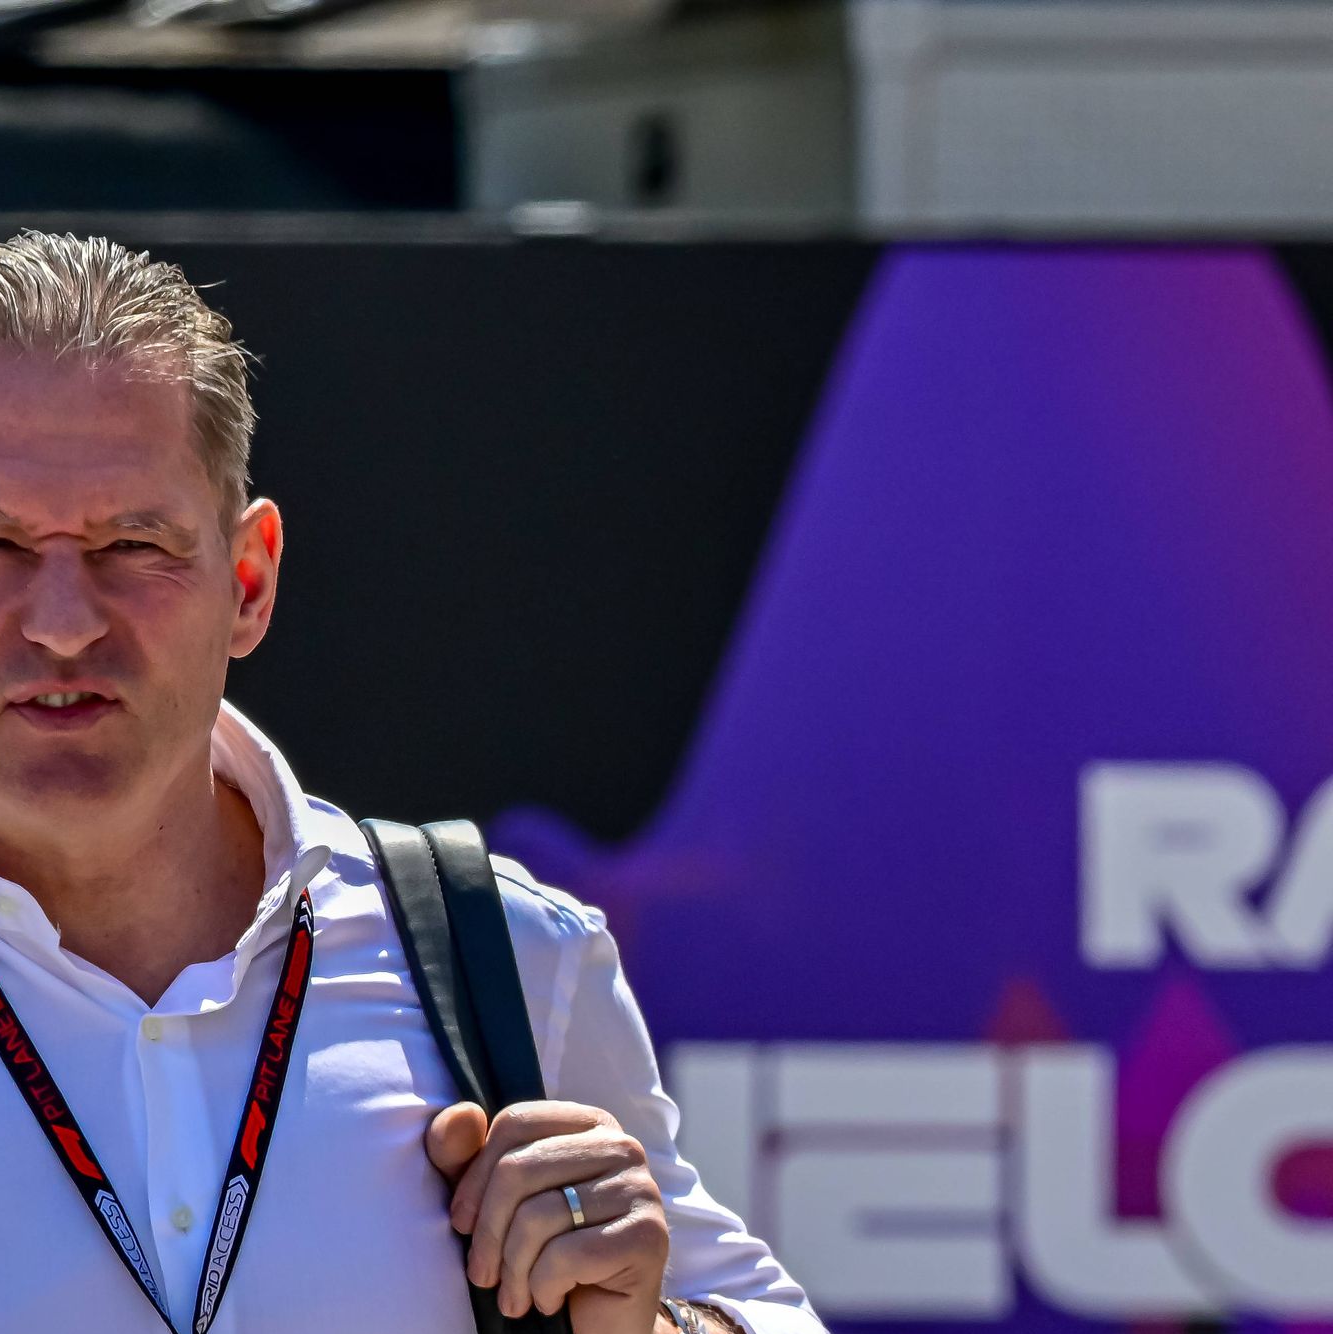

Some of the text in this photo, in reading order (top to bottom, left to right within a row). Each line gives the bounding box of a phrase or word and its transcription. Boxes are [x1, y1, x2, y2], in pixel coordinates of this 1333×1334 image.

[256, 1060, 278, 1102] PIT
[270, 997, 297, 1060] LANE
[29, 1084, 65, 1122] PIT
[100, 1204, 149, 1276] ACCESS
[202, 1191, 243, 1317] GRID ACCESS
